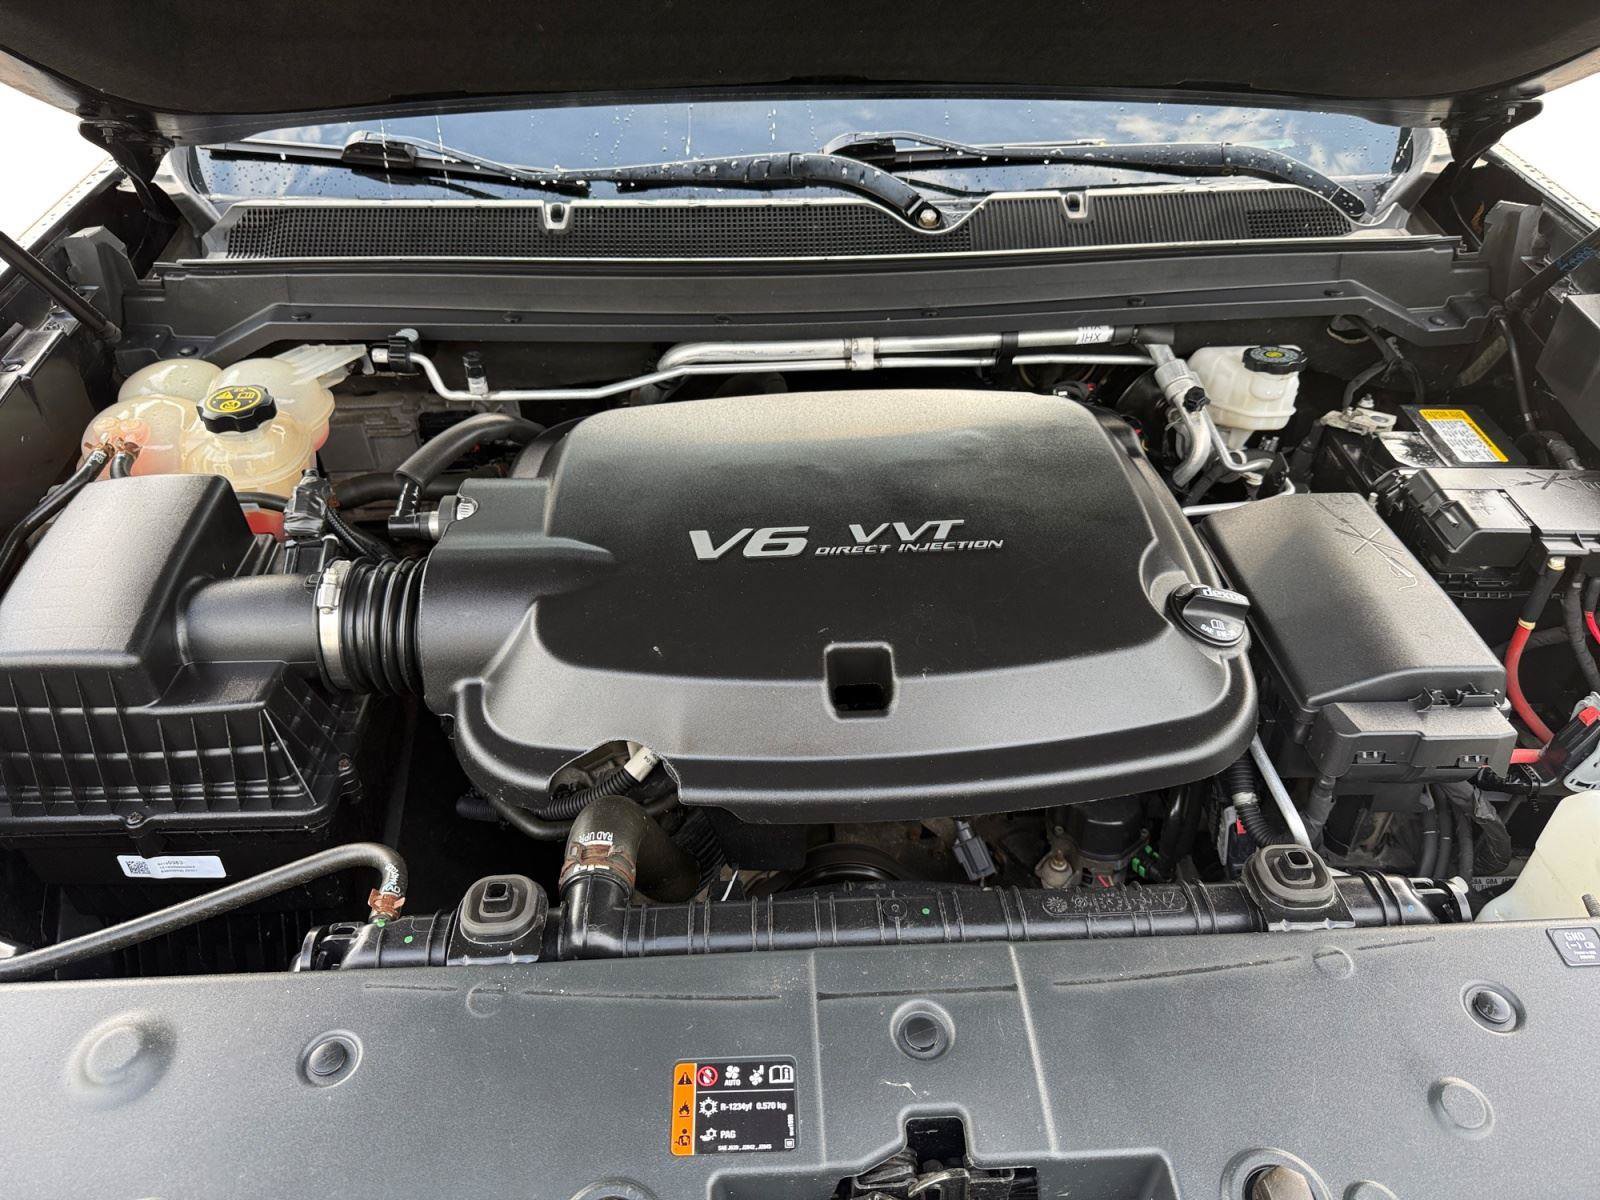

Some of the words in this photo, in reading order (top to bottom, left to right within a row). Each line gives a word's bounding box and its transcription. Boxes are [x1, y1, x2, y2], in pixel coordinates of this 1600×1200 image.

[848, 519, 965, 543] VVT
[689, 525, 810, 561] V6
[814, 543, 892, 556] DIRECT
[897, 539, 1004, 553] INJECTION
[579, 832, 595, 843] UPR
[596, 832, 613, 841] RAD
[720, 1102, 753, 1112] R-1234yf
[756, 1102, 776, 1111] 0.570
[777, 1102, 787, 1111] kg
[720, 1130, 737, 1139] PAG
